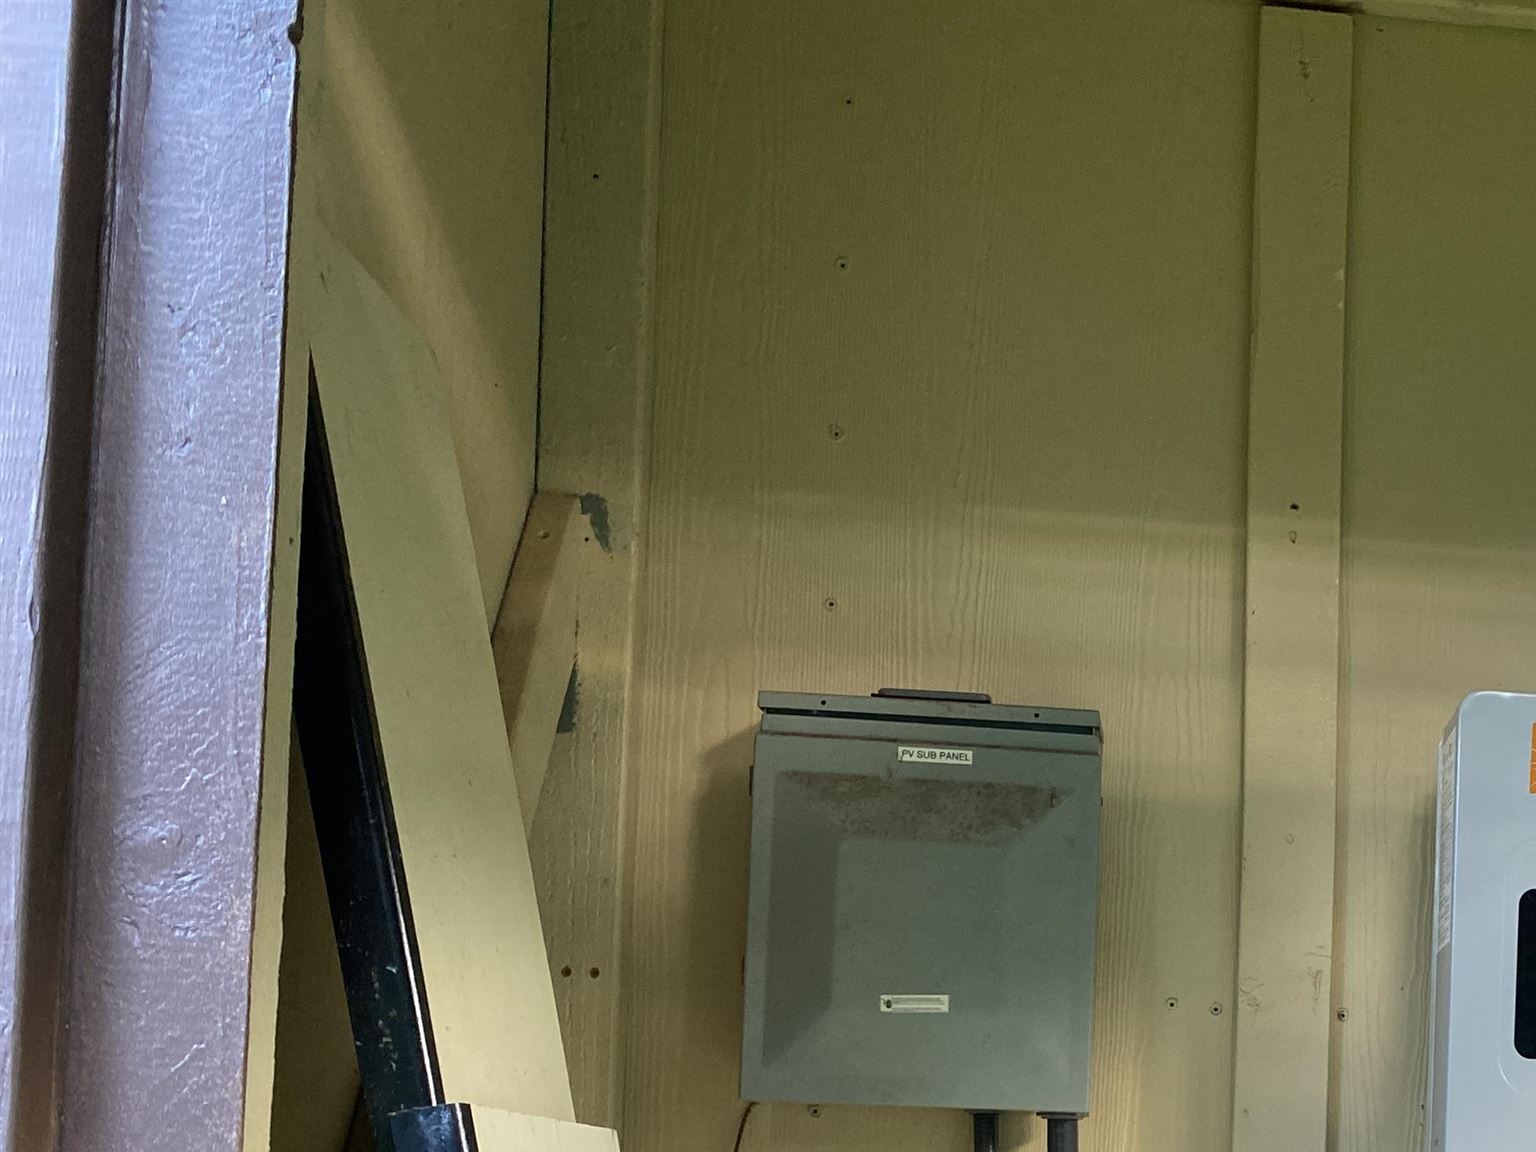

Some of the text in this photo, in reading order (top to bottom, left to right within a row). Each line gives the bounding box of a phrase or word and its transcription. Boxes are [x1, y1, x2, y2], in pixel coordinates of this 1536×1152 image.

[901, 749, 970, 762] PV SUB PANEL
